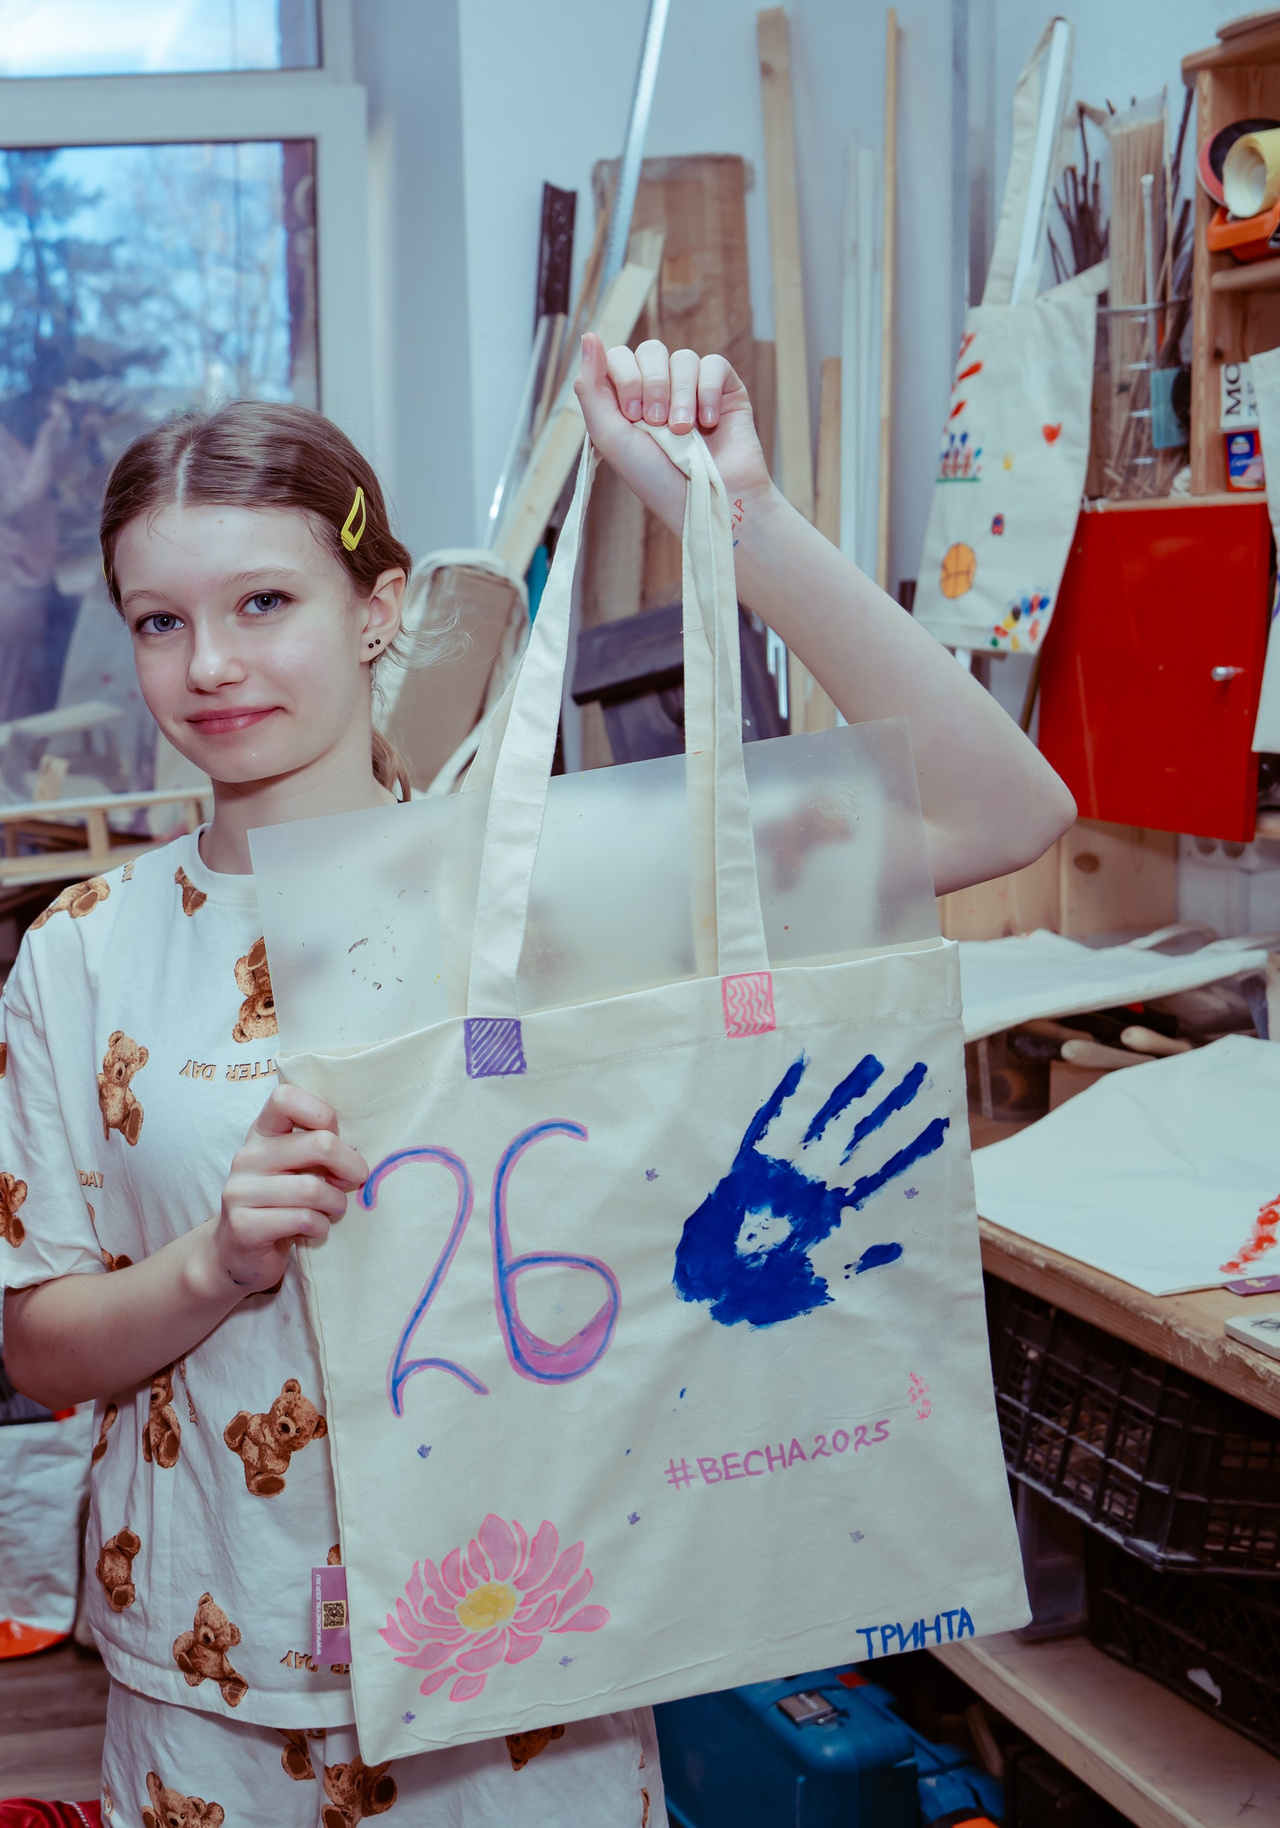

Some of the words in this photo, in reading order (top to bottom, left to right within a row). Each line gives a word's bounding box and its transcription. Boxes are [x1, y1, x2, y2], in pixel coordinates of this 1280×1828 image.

[179, 1059, 217, 1082] DAY
[226, 1058, 277, 1082] TTER
[77, 1169, 105, 1188] DAY
[350, 1118, 622, 1417] 26
[855, 1606, 975, 1660] ТРИНТА
